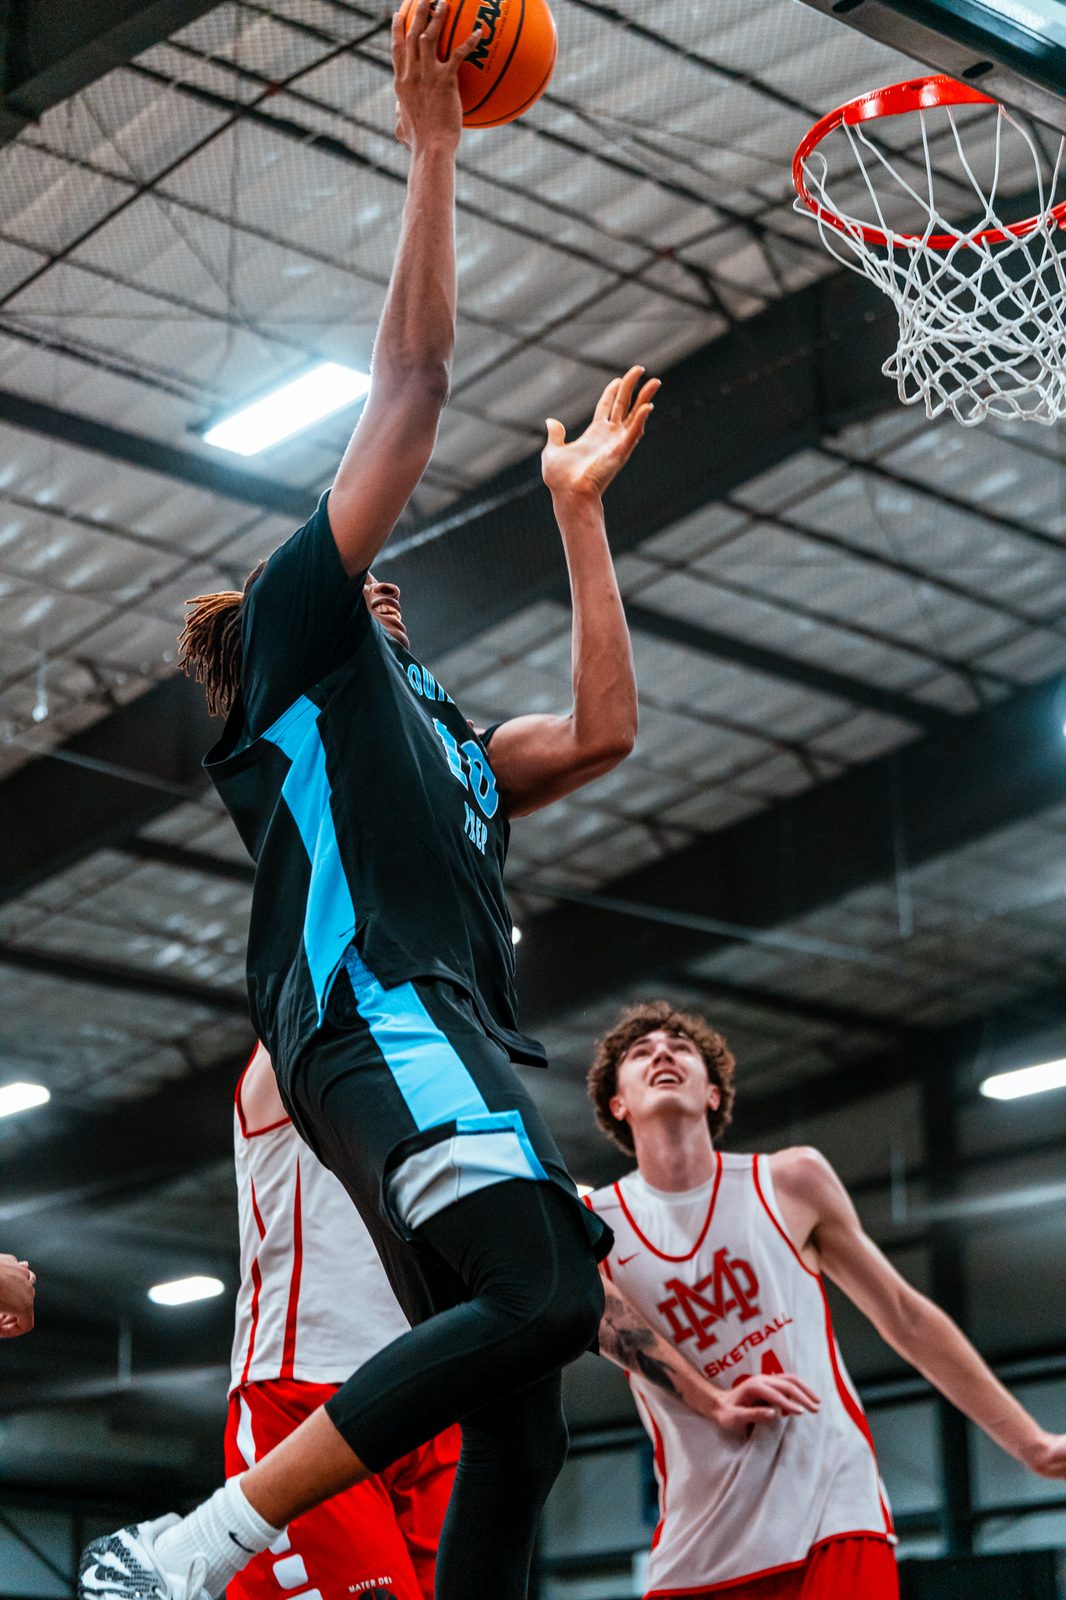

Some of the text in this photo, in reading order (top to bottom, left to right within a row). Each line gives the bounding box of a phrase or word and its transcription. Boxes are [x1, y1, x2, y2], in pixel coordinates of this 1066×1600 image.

[432, 717, 499, 819] 10
[703, 1312, 793, 1379] SKETBALL
[348, 1576, 393, 1593] MATER DEI
